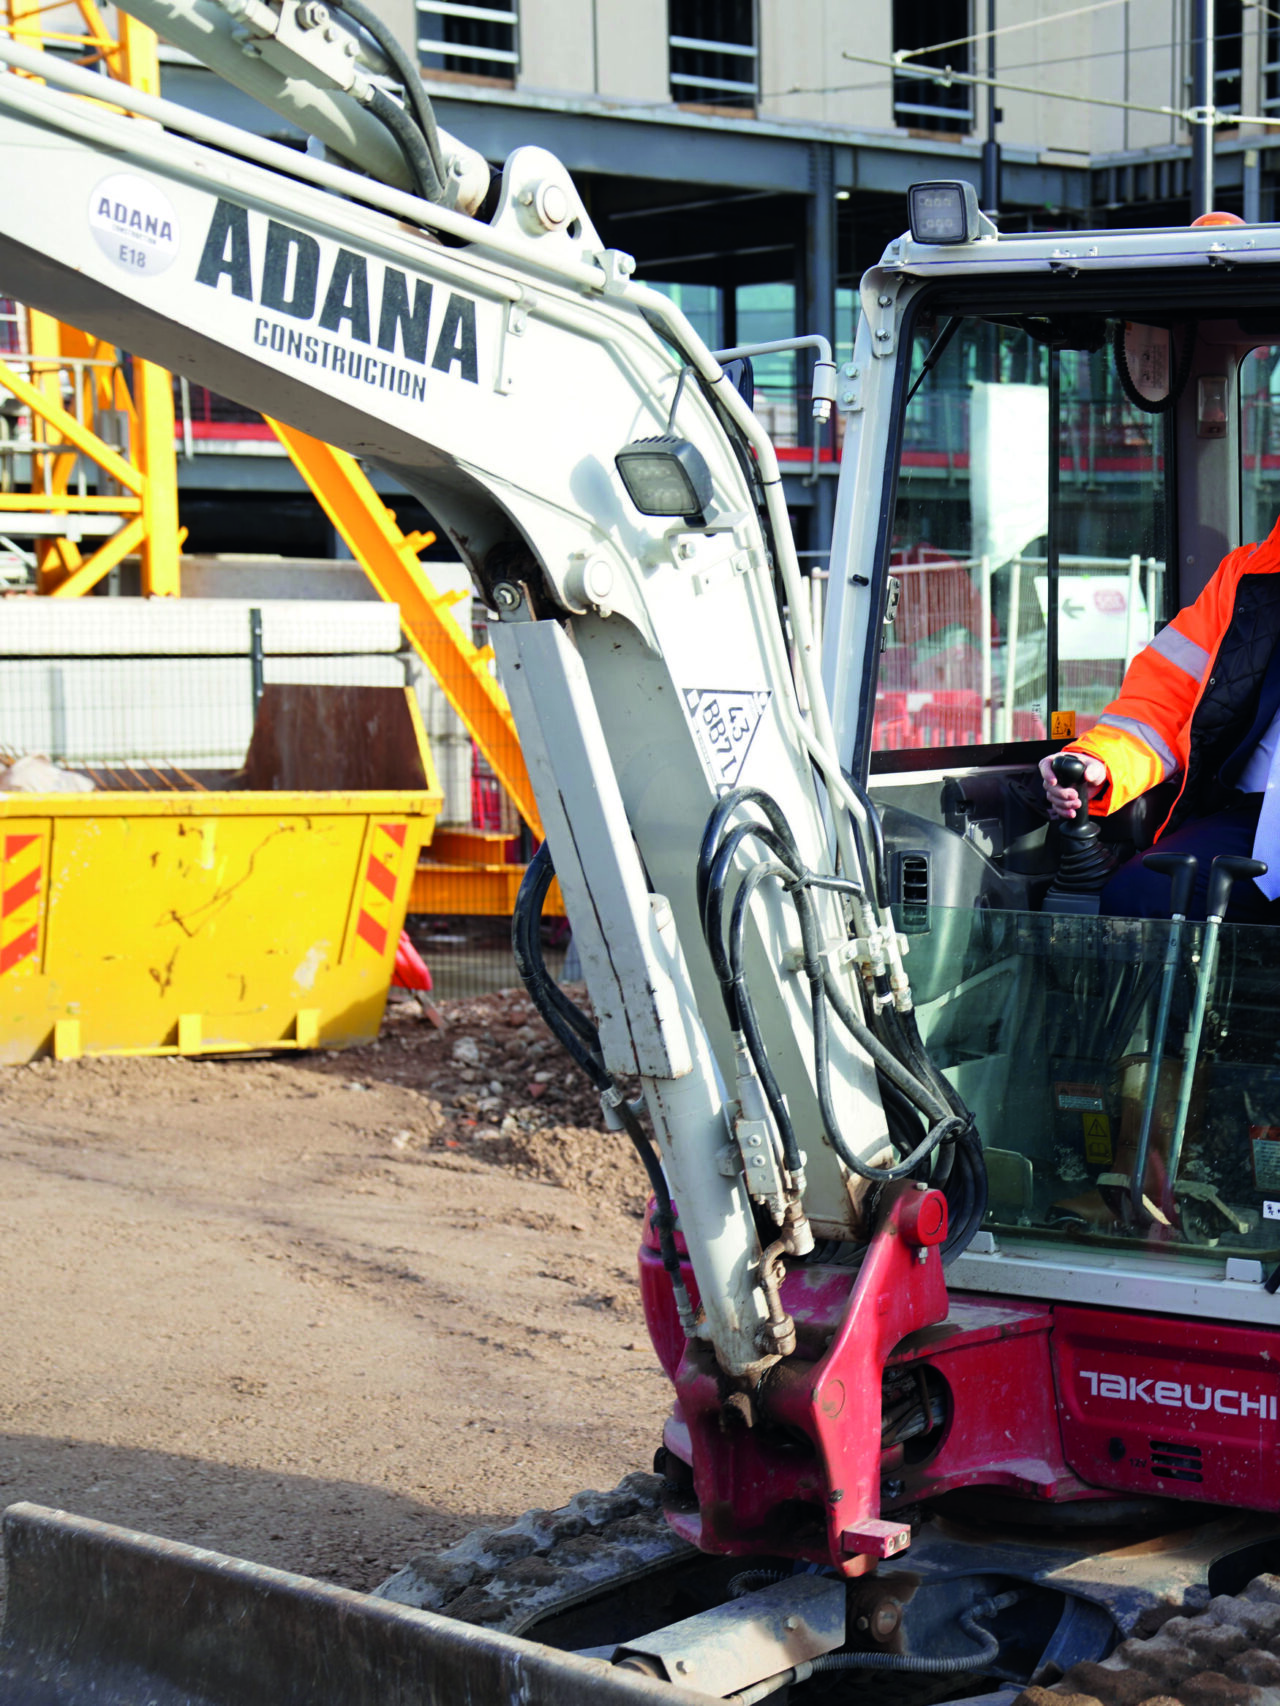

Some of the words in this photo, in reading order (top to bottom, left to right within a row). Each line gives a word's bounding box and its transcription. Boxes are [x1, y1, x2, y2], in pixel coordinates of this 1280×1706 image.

[97, 196, 173, 242] ADANA
[119, 244, 146, 268] E18
[194, 197, 479, 385] ADANA
[253, 317, 427, 402] CONSTRUCTION
[728, 706, 750, 742] 43
